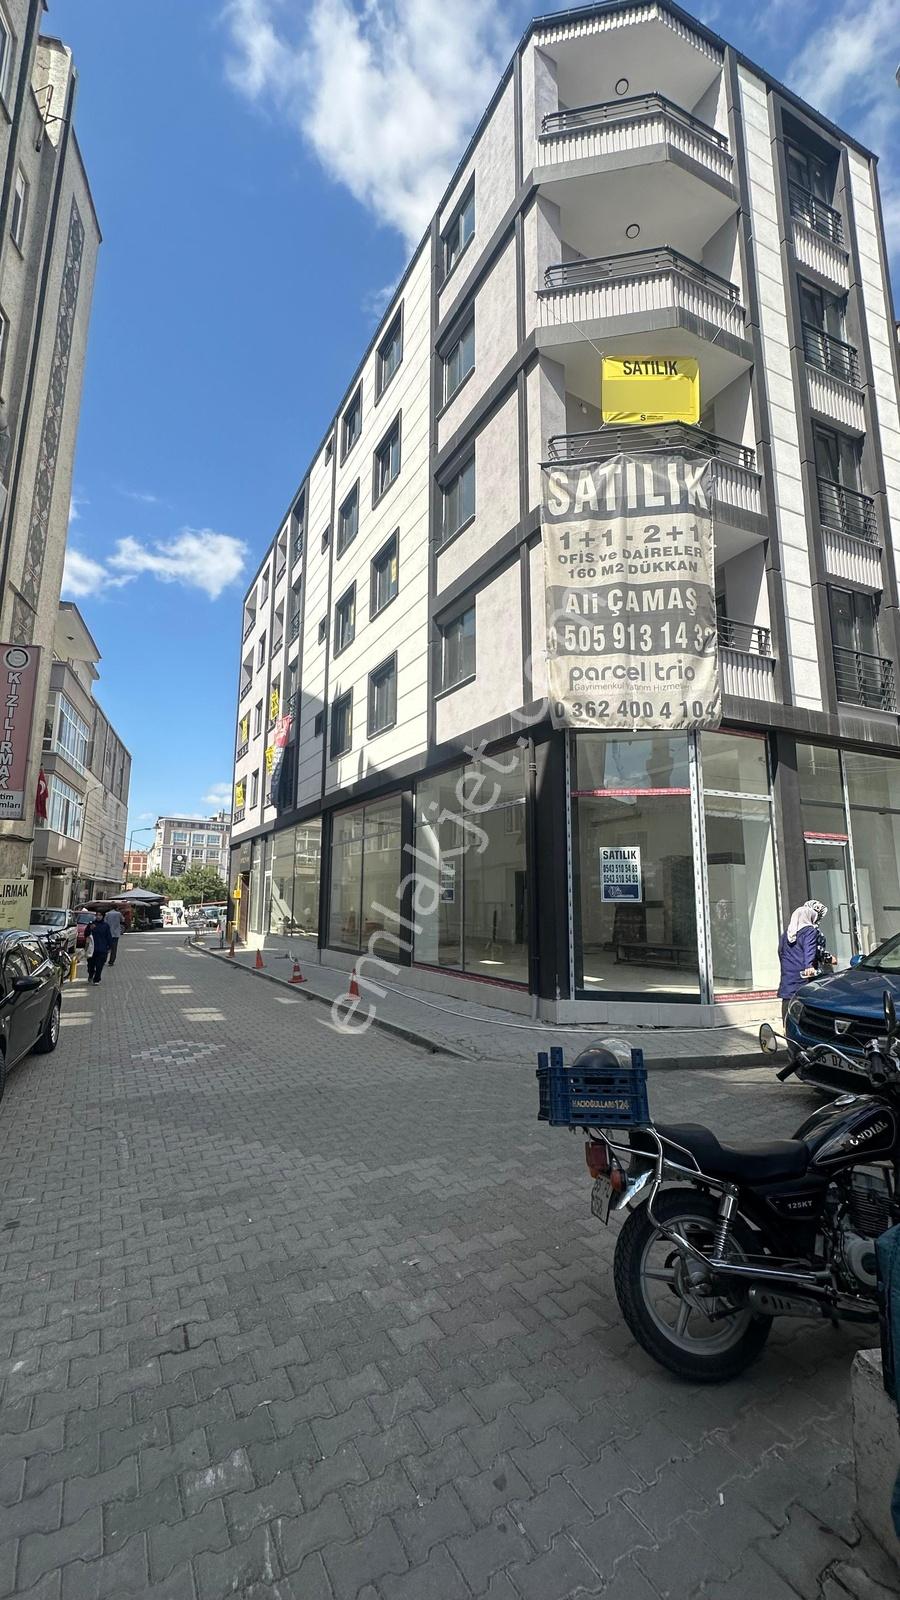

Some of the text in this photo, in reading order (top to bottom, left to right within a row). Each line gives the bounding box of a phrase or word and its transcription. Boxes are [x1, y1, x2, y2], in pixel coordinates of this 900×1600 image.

[623, 360, 678, 375] SATILIK
[548, 462, 710, 516] SATILIK
[558, 545, 703, 564] OFİS ve DAİRELER
[568, 560, 697, 578] 160 M2 DÜKKAN
[565, 587, 698, 616] Ali ÇAMAŞ
[564, 624, 605, 651] 505
[612, 622, 652, 652] 913
[660, 622, 688, 649] 14
[569, 659, 695, 691] parcel trio
[555, 700, 716, 719] 0 362 400 4 104
[603, 850, 637, 860] SATILIK
[0, 884, 28, 898] IRMAK
[842, 1121, 888, 1149] ONDIAL
